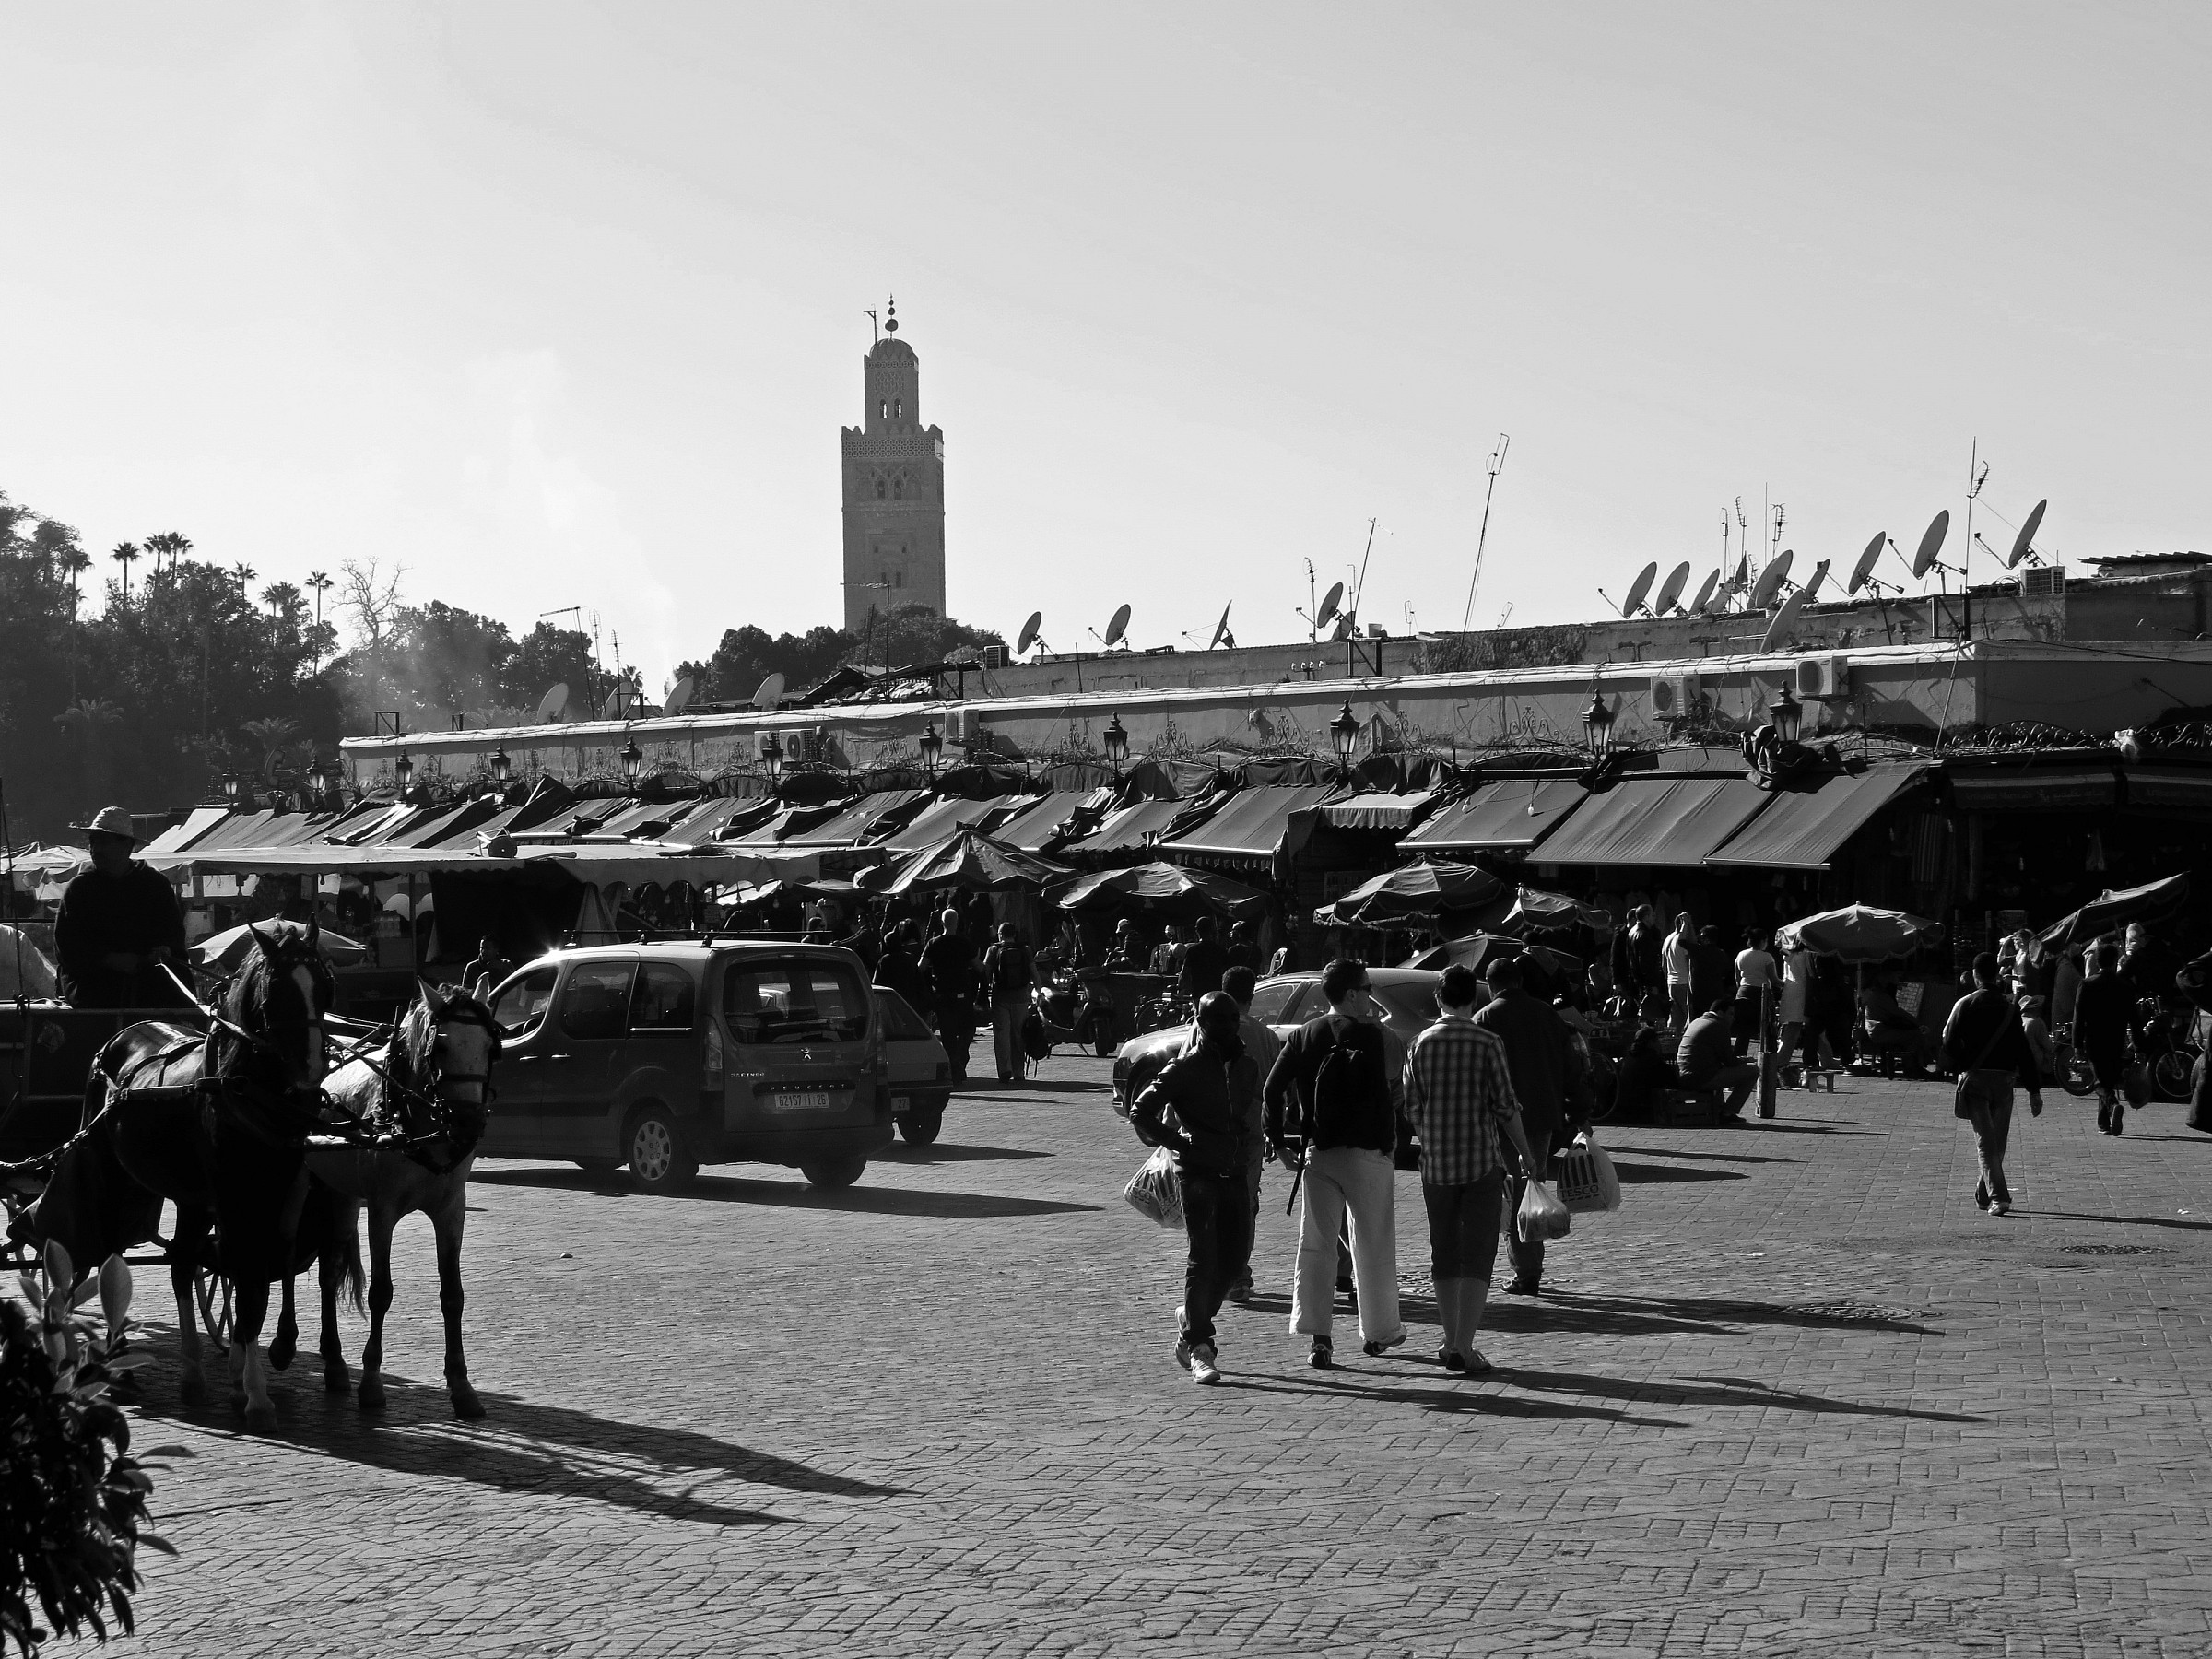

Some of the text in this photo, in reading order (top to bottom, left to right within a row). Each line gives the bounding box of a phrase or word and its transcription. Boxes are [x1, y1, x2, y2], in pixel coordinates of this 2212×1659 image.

[816, 1093, 827, 1105] 26
[1132, 1186, 1151, 1200] SCO
[1559, 1184, 1599, 1198] TESCO
